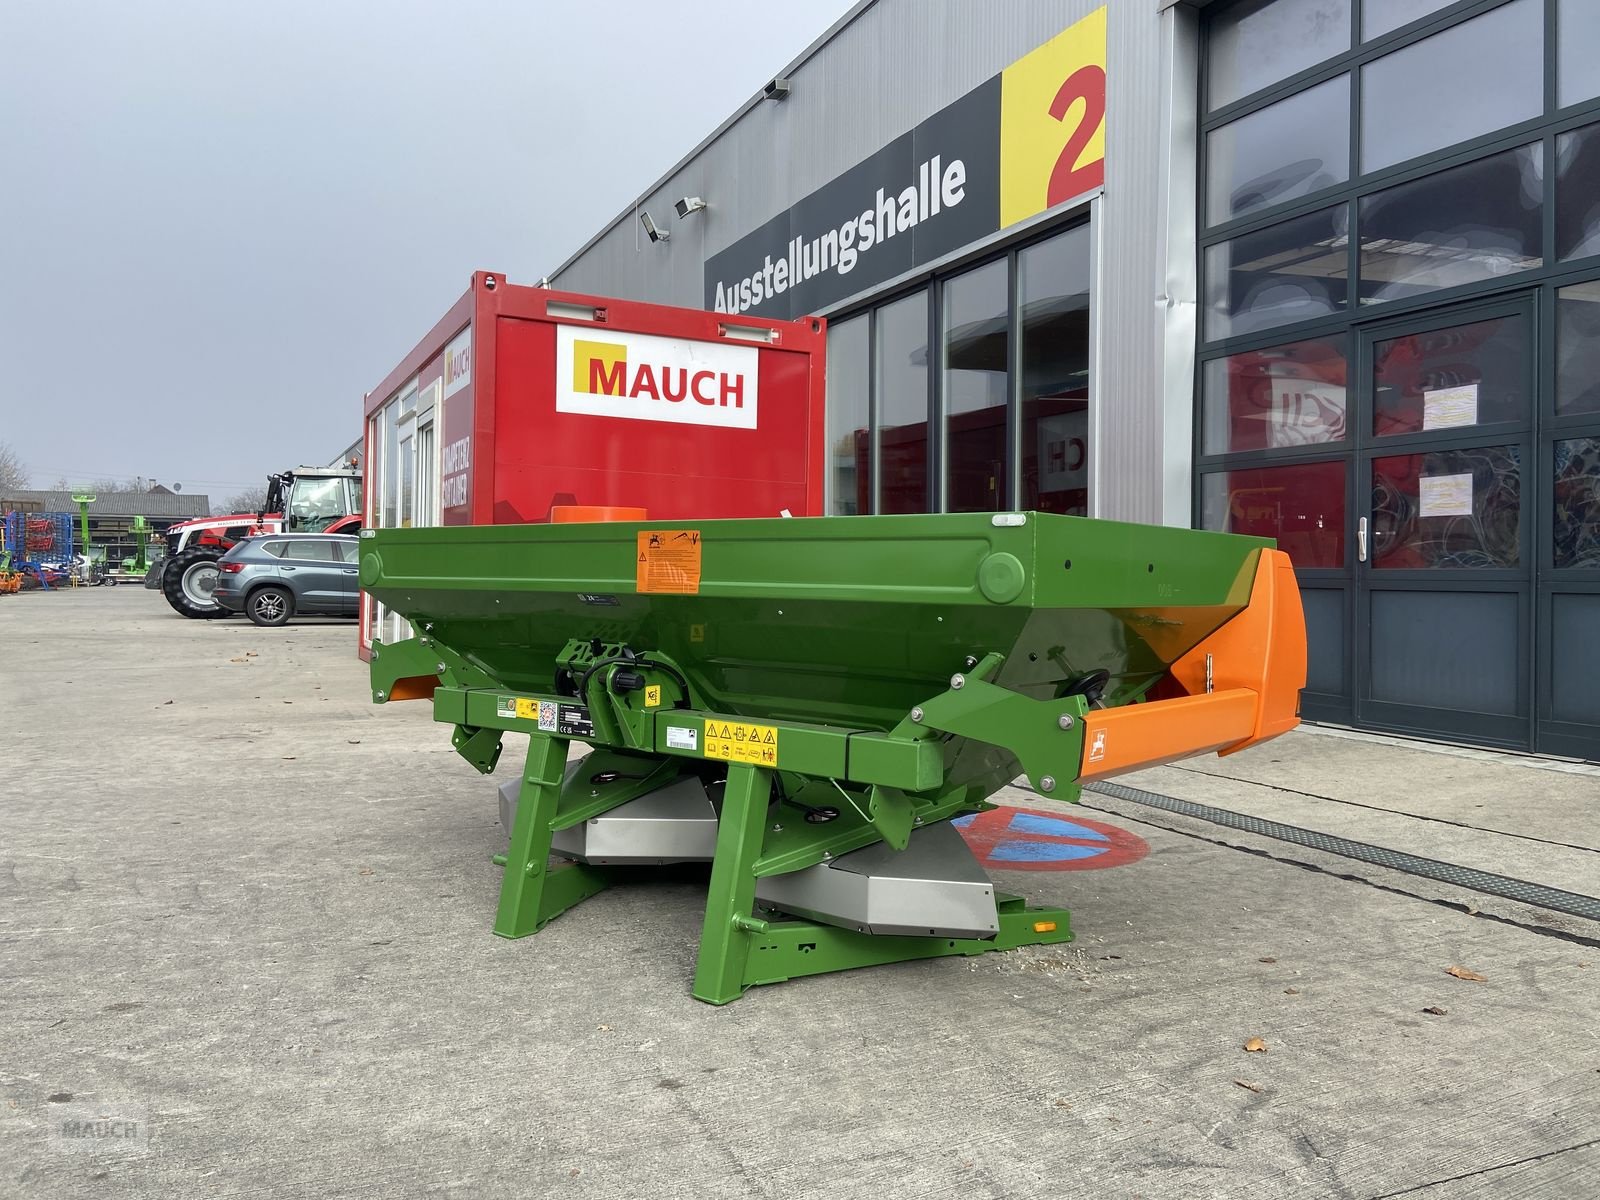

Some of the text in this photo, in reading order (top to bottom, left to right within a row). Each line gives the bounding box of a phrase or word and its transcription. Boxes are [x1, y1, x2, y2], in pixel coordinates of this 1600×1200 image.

[714, 63, 1106, 315] Ausstellungshalle 2
[446, 345, 470, 385] MAUCH
[588, 358, 744, 409] MAUCH
